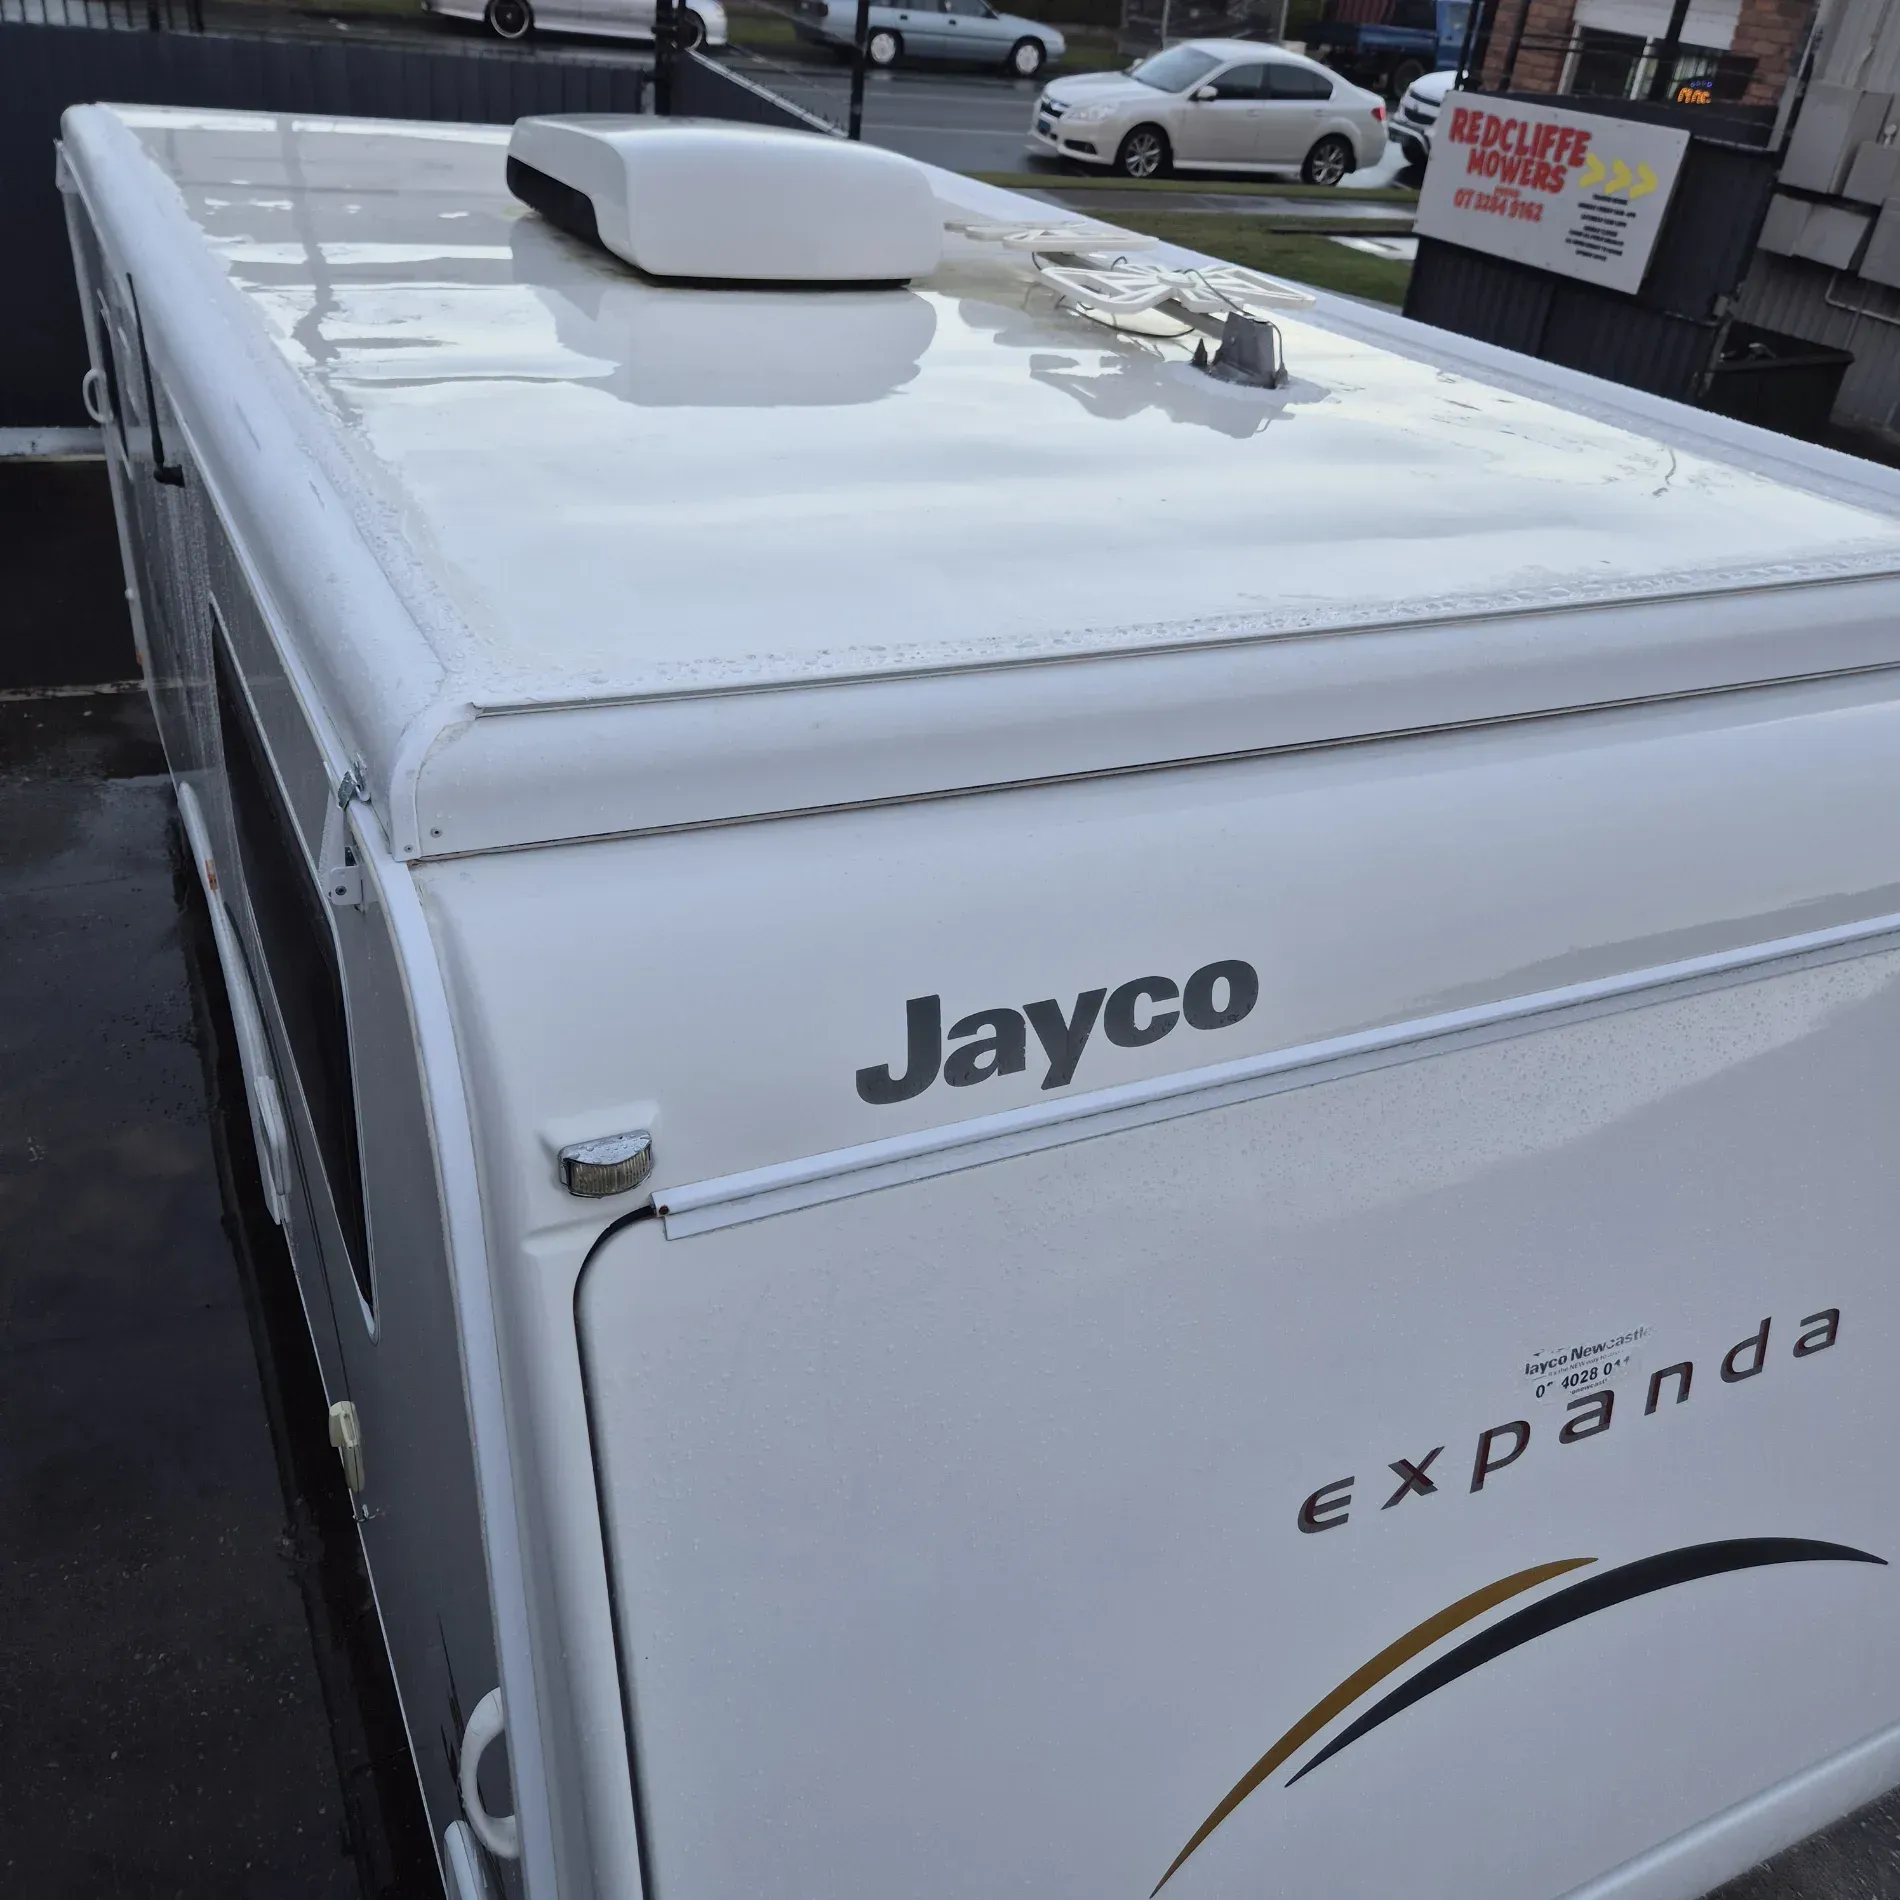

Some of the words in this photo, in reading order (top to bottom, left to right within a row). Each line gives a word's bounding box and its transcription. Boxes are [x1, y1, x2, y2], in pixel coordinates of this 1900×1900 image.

[1448, 107, 1592, 168] REDCLIFFE
[1467, 148, 1567, 194] MOWERS
[1453, 188, 1475, 209] 07
[855, 959, 1259, 1105] Jayco
[1561, 1367, 1598, 1389] 4028
[1297, 1308, 1840, 1534] expanda
